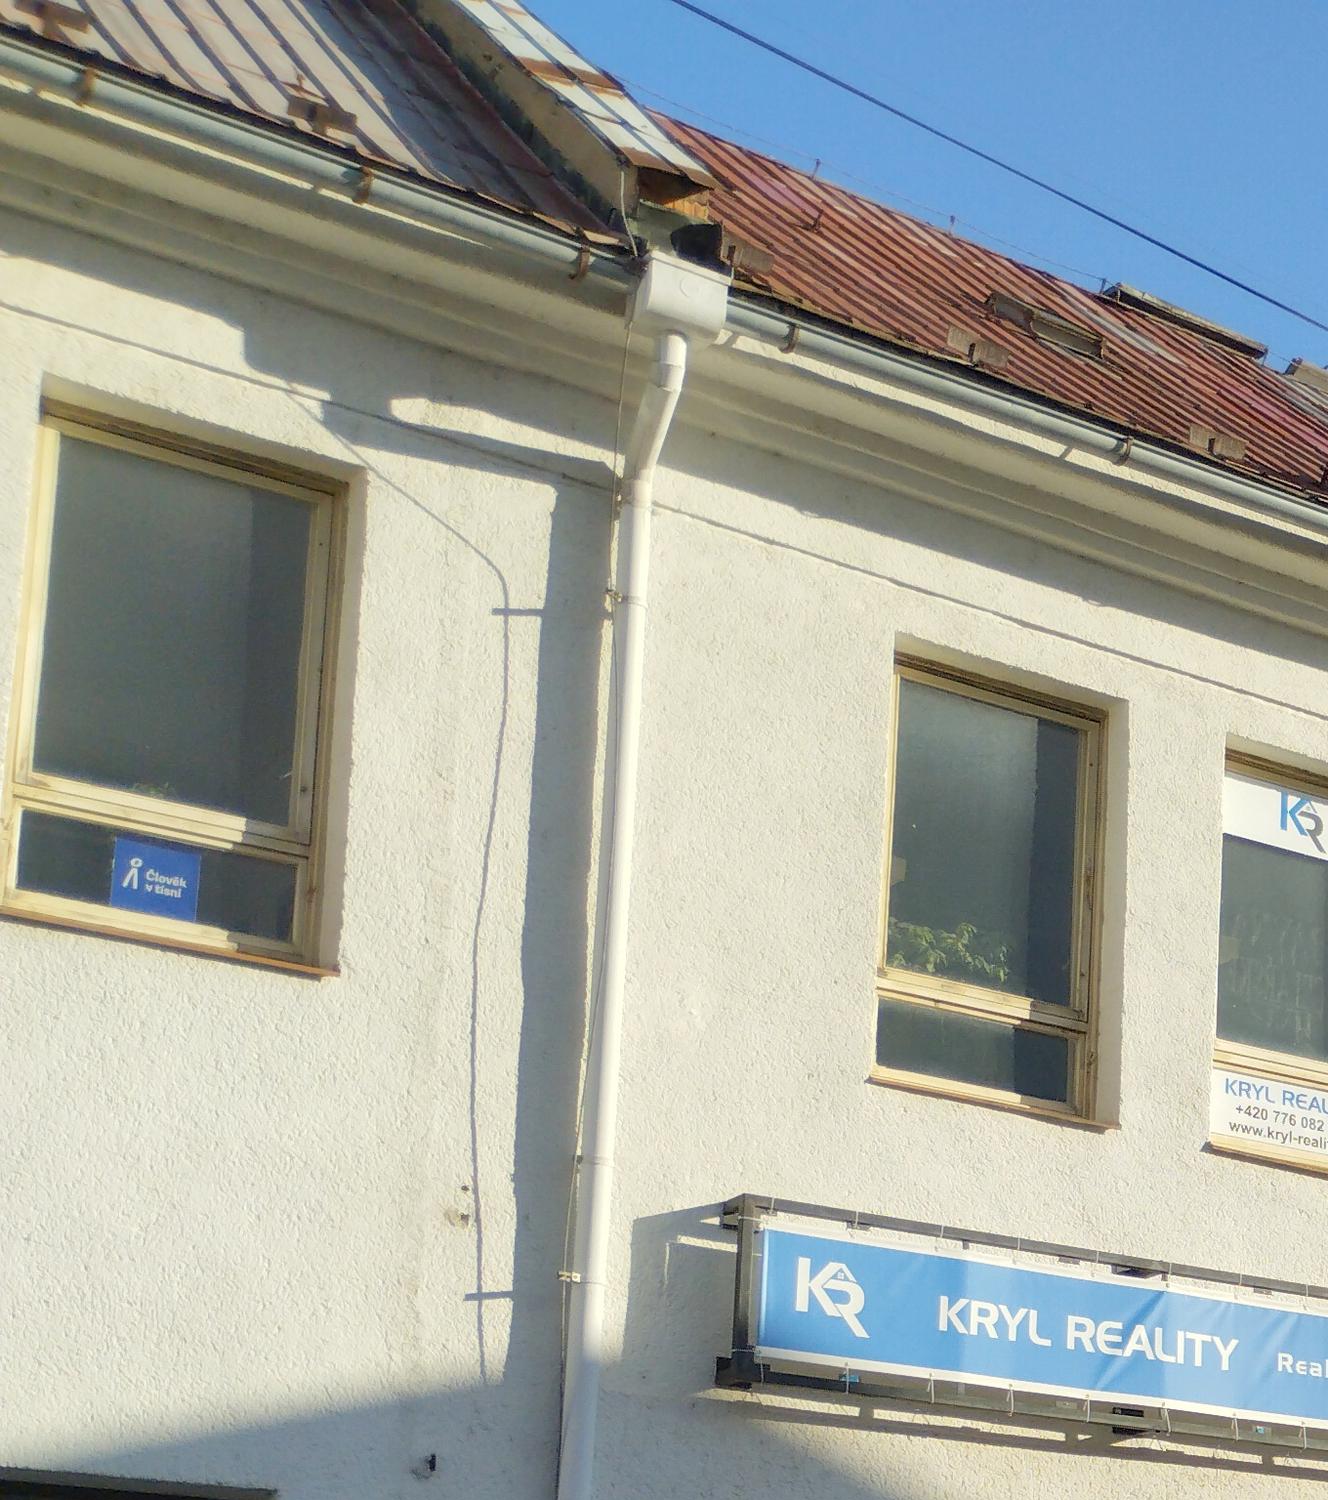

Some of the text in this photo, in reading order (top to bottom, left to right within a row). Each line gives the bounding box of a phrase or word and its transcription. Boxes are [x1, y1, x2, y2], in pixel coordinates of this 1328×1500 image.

[145, 869, 187, 888] Člověk
[145, 883, 153, 892] v
[1225, 1077, 1276, 1104] KRYL
[1236, 1104, 1269, 1121] +420
[1273, 1110, 1297, 1127] 776
[1301, 1116, 1325, 1132] 082
[937, 1295, 1052, 1347] KRYL
[1065, 1314, 1241, 1373] REALITY
